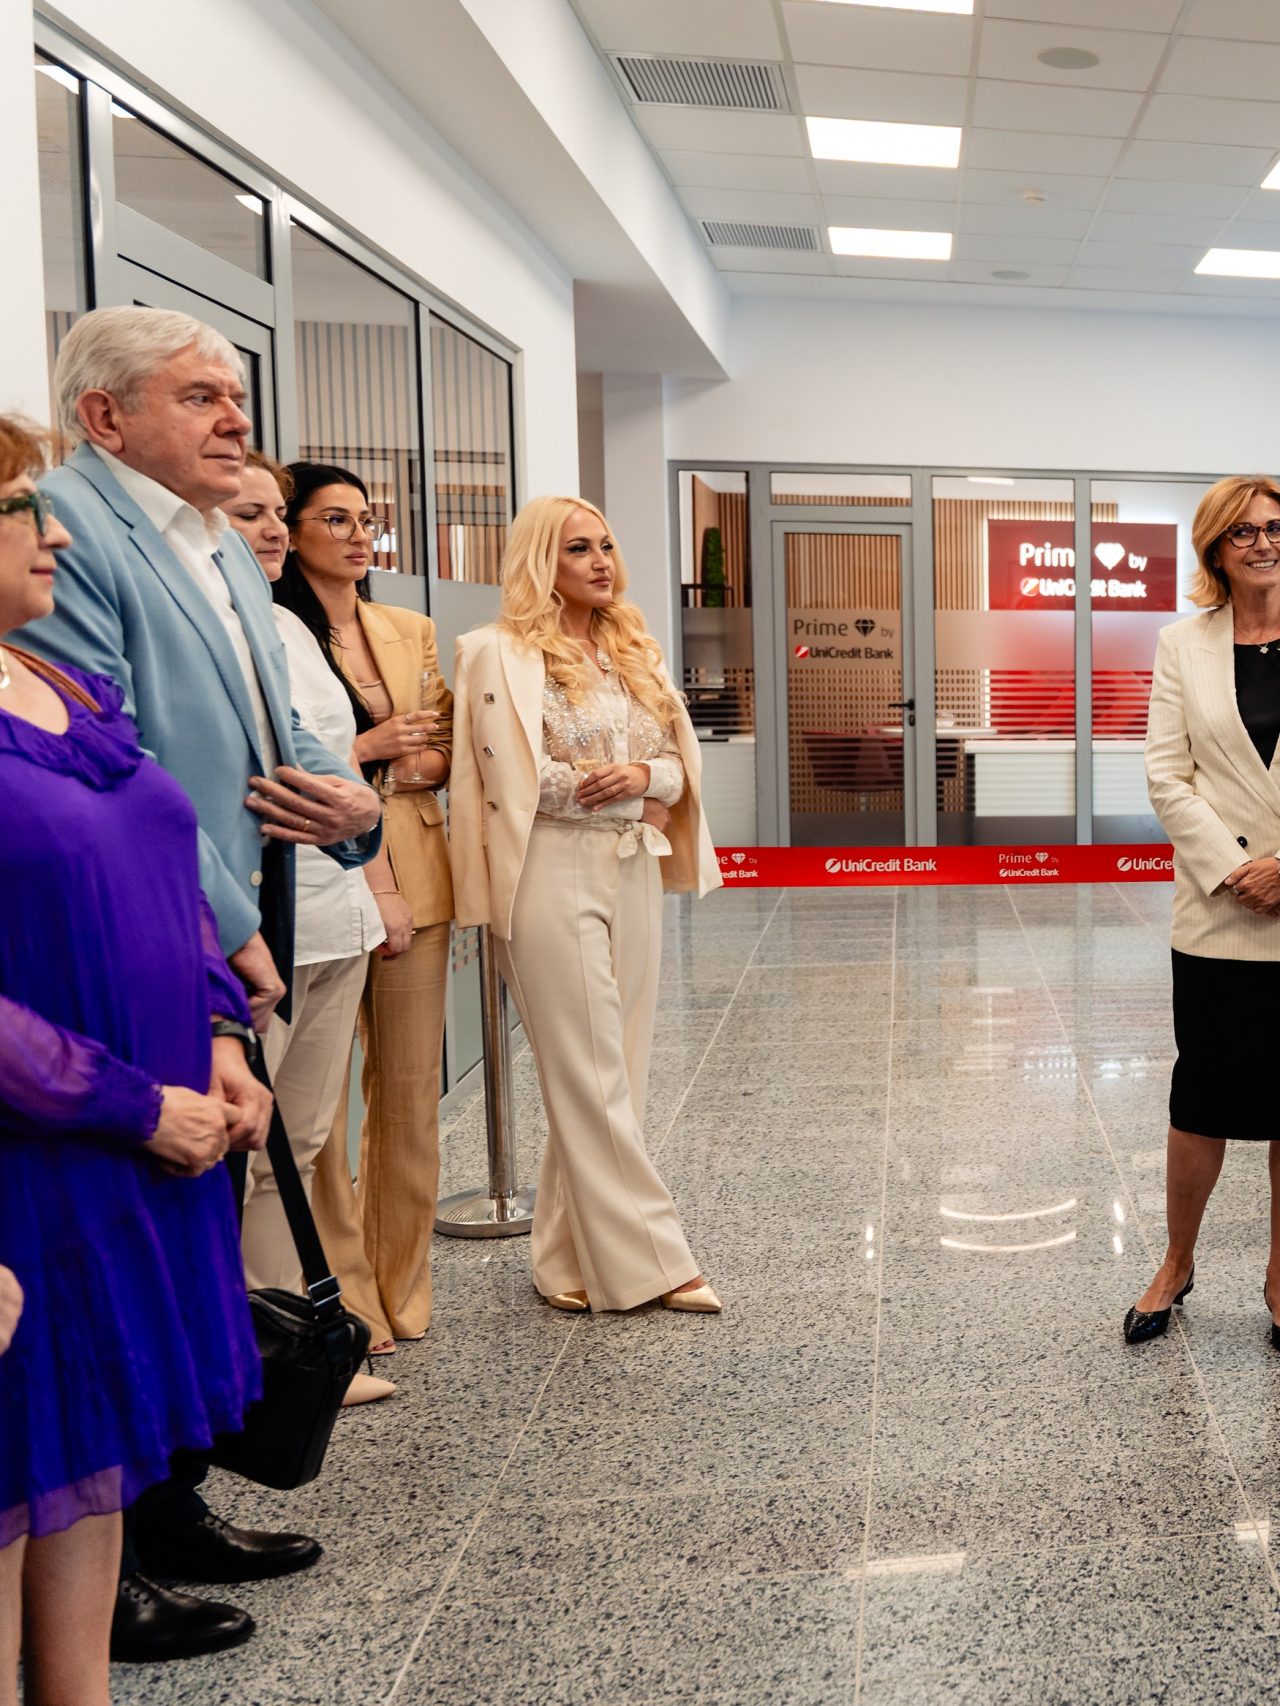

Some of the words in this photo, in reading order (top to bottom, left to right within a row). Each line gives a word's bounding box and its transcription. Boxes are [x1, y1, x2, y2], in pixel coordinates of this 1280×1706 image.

[1019, 542, 1076, 567] Prim
[1128, 552, 1148, 572] by
[1108, 578, 1147, 598] Bank
[793, 618, 848, 637] Prime
[881, 626, 895, 639] by
[809, 646, 862, 659] UniCredit
[865, 647, 894, 659] Bank
[841, 858, 901, 873] UniCredit
[903, 857, 937, 872] Bank
[998, 853, 1032, 864] Prime
[1133, 857, 1175, 871] UniCre
[738, 869, 759, 879] Bank
[1008, 868, 1040, 877] UniCredit
[1041, 868, 1059, 877] Bank
